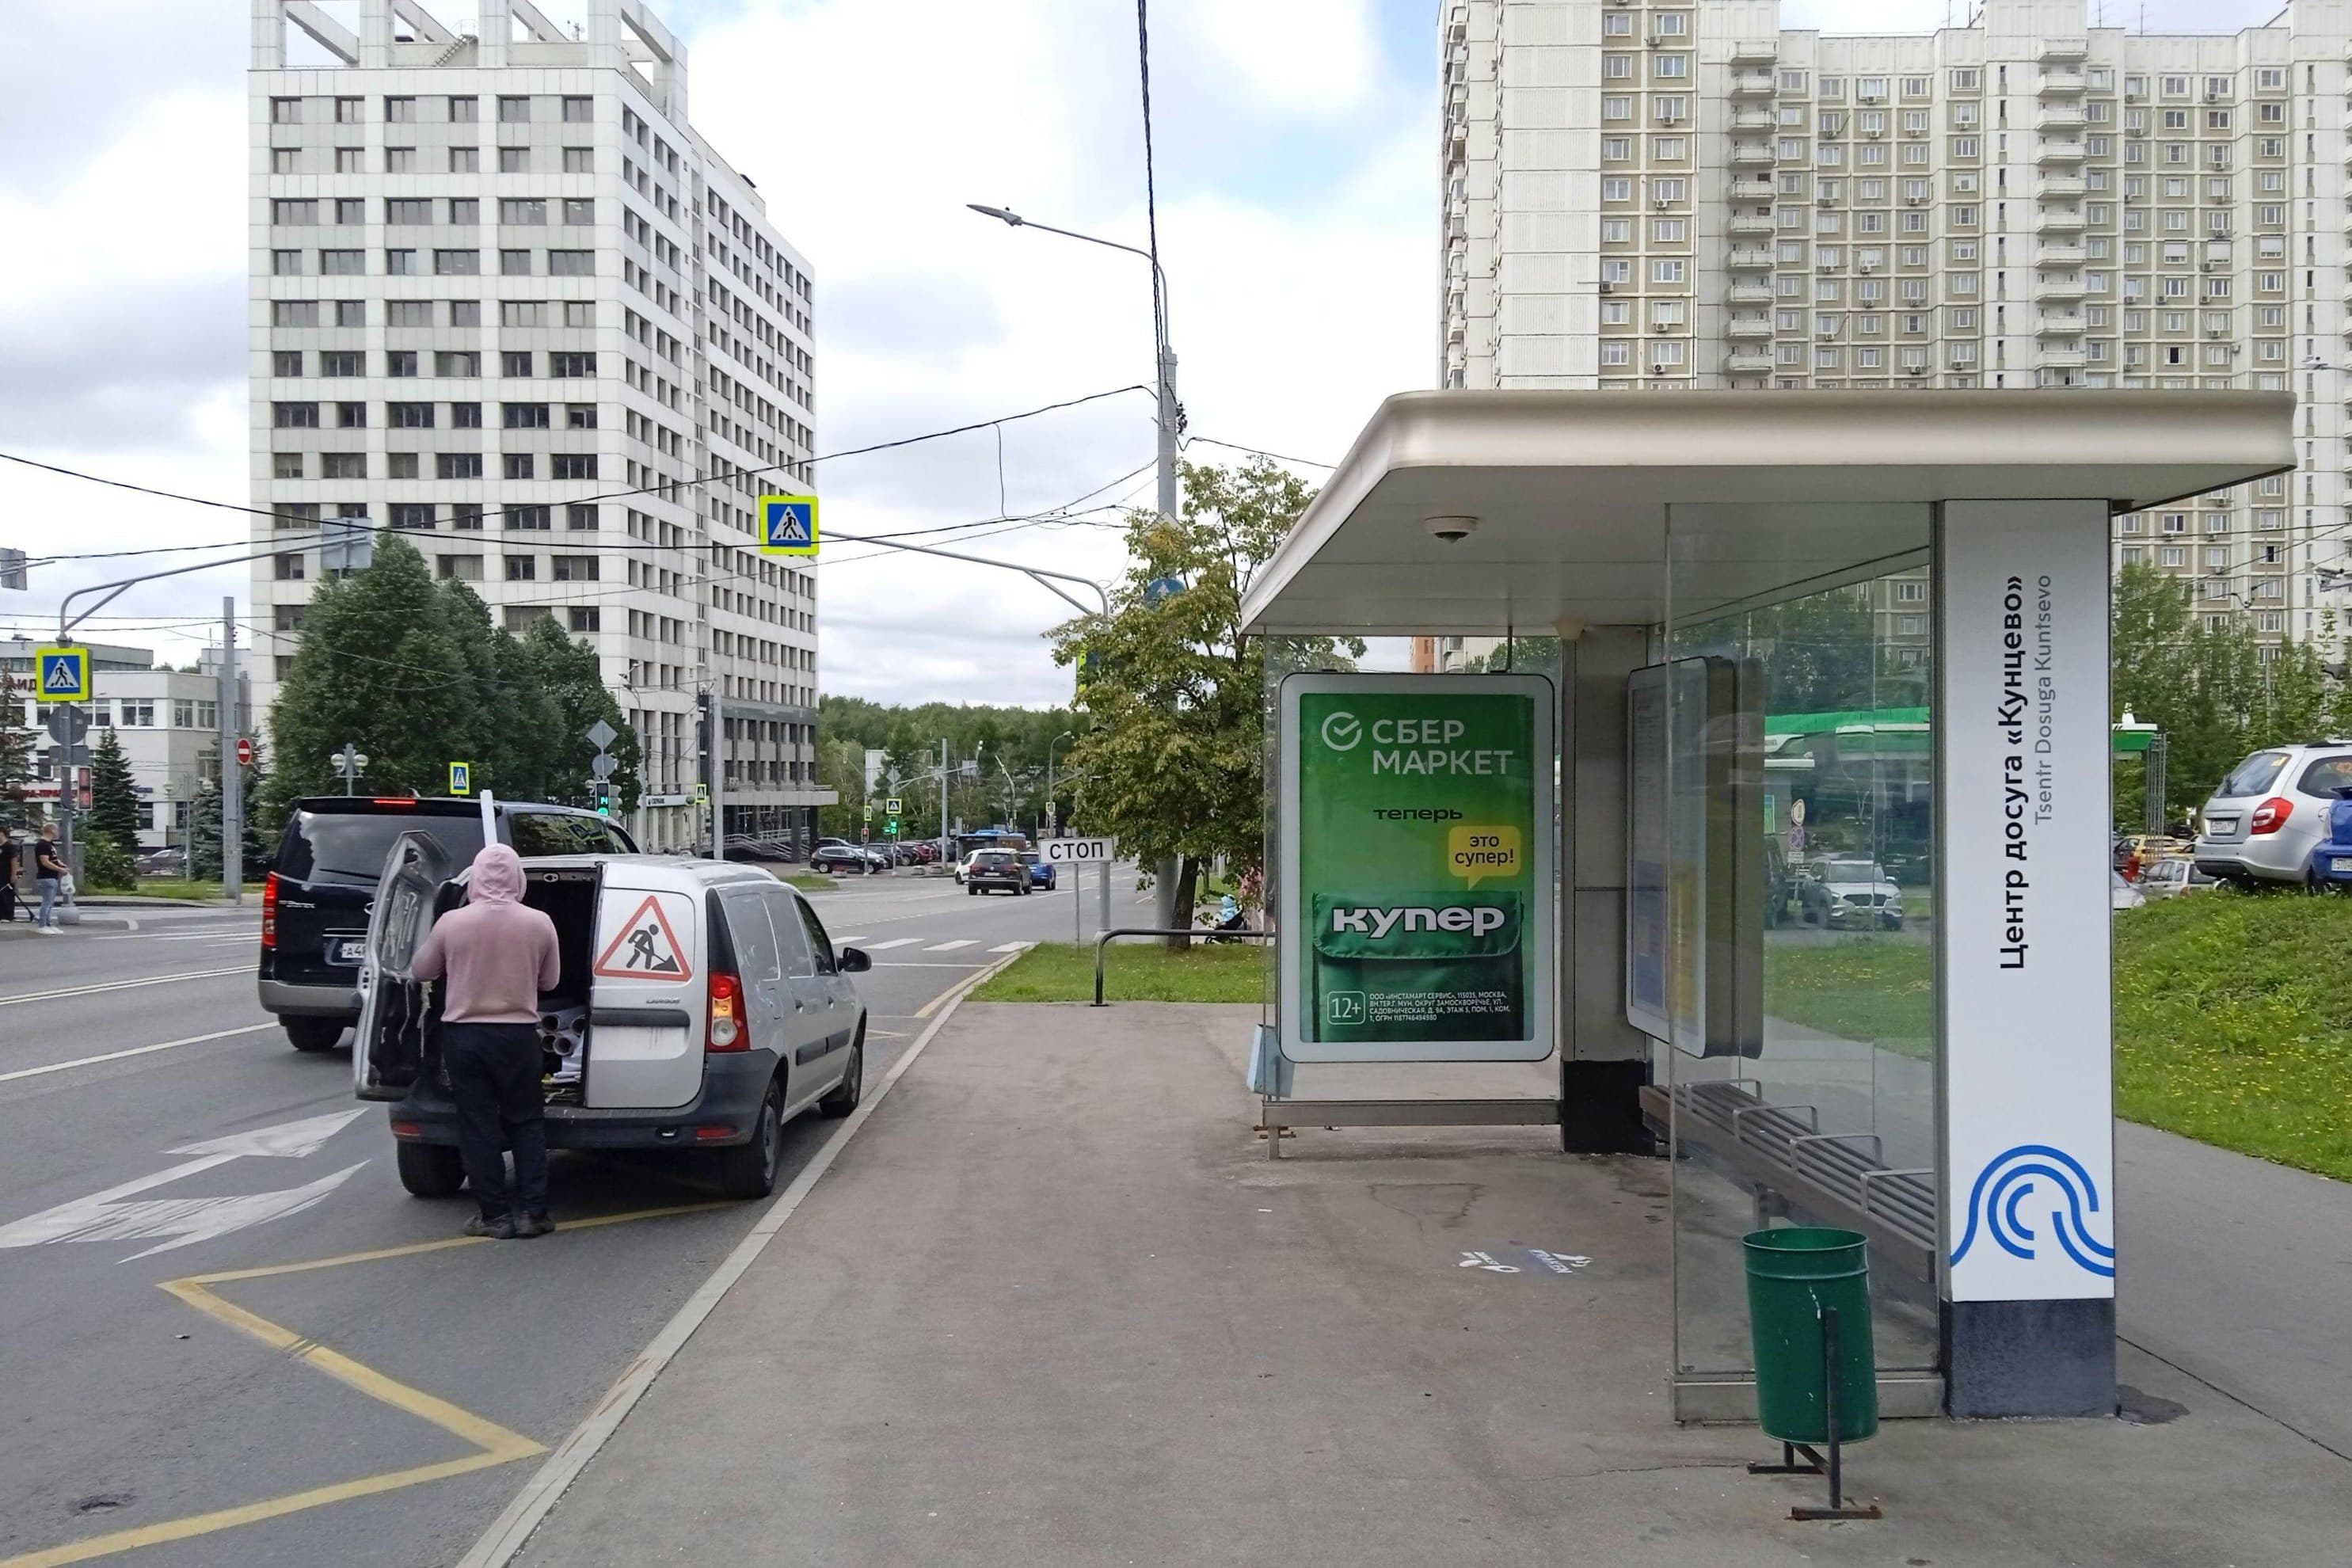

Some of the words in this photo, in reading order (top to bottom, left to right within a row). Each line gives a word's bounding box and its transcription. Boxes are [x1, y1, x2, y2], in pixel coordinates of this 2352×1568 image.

[2034, 575, 2052, 671] Kuntsevo
[1998, 576, 2028, 745] «Кунцево»
[2034, 676, 2056, 753] Dosuga
[1372, 719, 1464, 744] СБЕР
[1372, 750, 1513, 775] МАРКЕТ
[2034, 760, 2052, 825] Tsentr
[1373, 809, 1463, 824] теперь
[2004, 755, 2029, 861] досуга
[1049, 842, 1104, 860] СТОП
[1469, 836, 1500, 847] это
[1455, 849, 1514, 867] супер!
[1333, 908, 1505, 939] купер
[2000, 870, 2030, 969] Центр
[1331, 998, 1361, 1018] 12+
